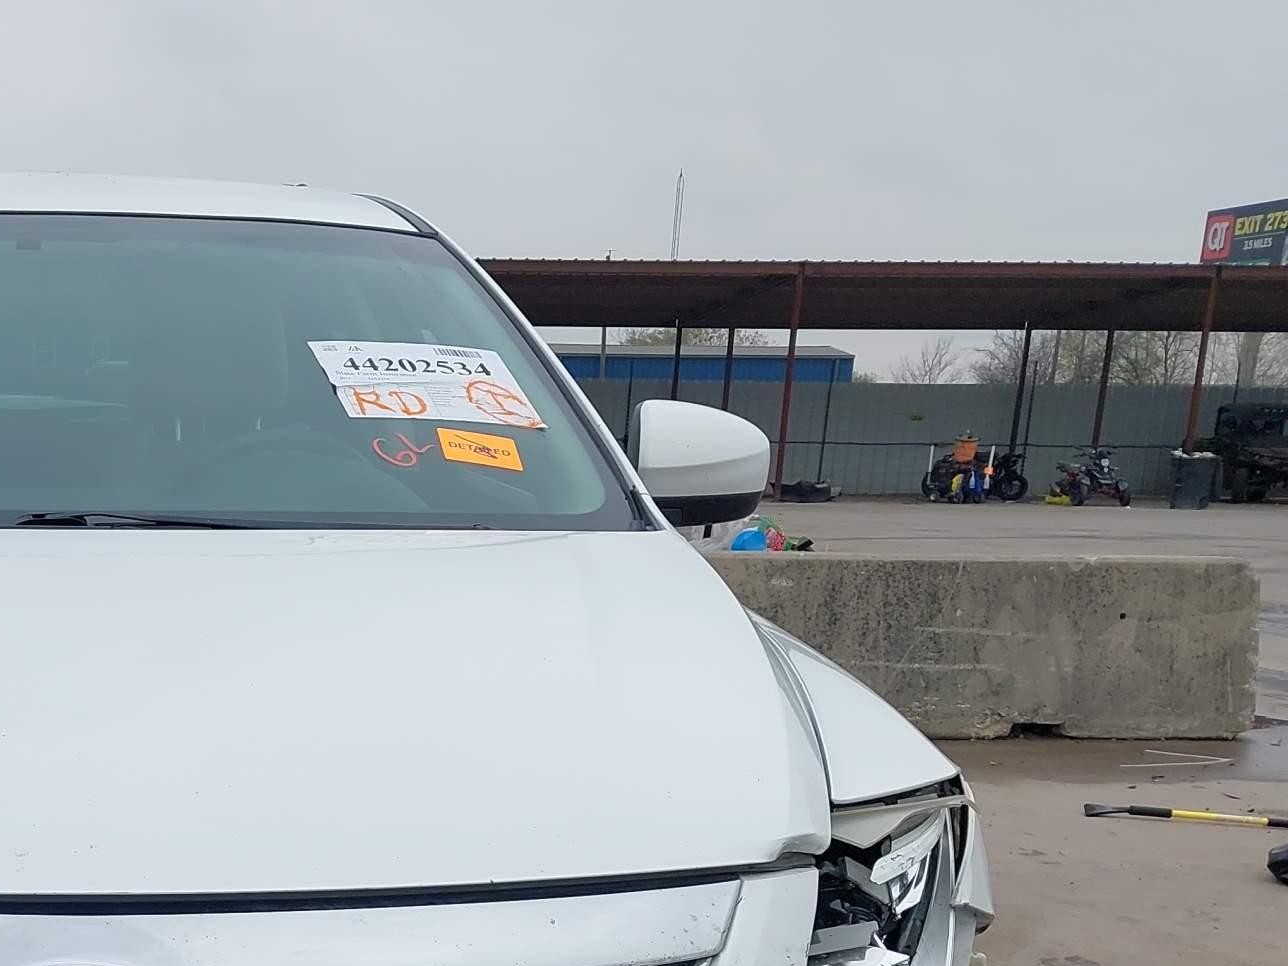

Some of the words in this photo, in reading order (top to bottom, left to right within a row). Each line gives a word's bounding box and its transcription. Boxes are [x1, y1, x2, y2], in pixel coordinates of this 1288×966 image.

[1208, 221, 1230, 251] QT
[1234, 214, 1264, 235] EXIT
[343, 357, 492, 376] 44202534
[350, 387, 428, 416] RD
